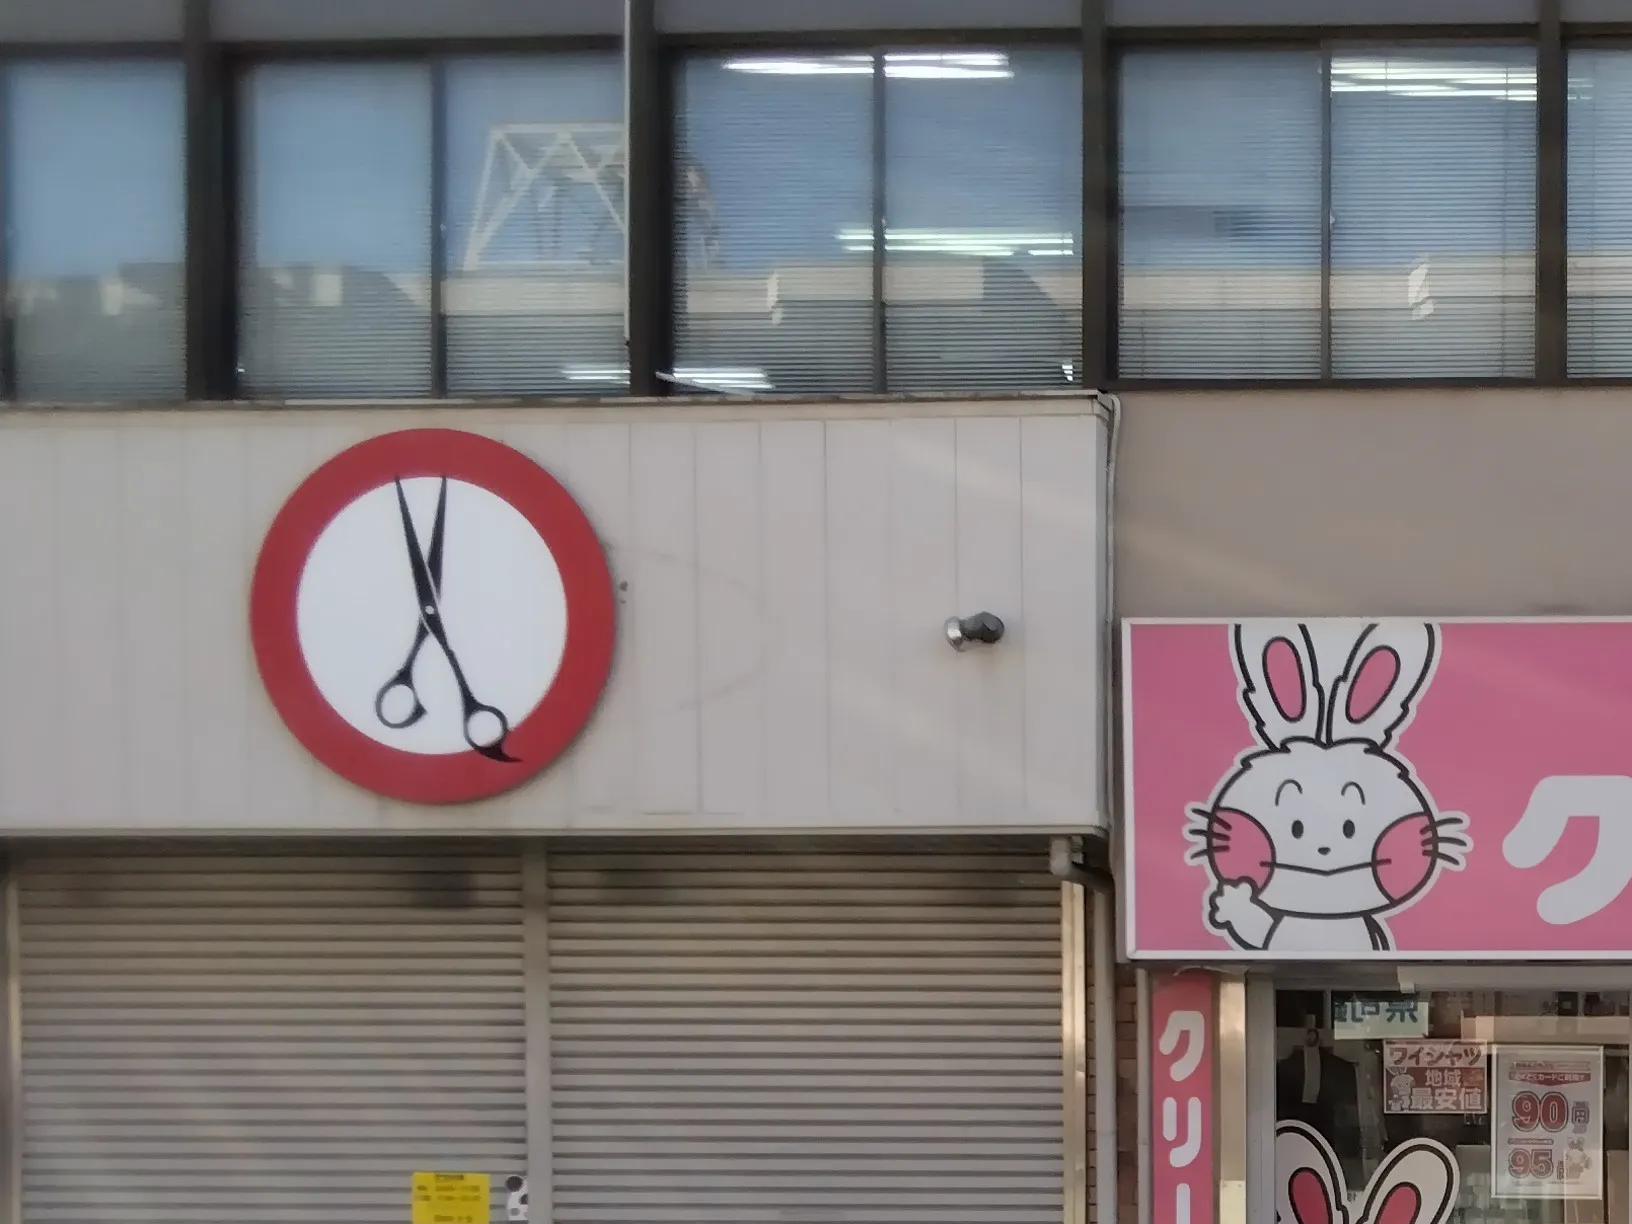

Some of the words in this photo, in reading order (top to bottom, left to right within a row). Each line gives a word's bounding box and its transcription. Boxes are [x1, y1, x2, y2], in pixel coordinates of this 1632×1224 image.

[1389, 1047, 1482, 1066] ワイシャツ
[1425, 1069, 1461, 1087] 地域
[1410, 1087, 1482, 1110] 最安値
